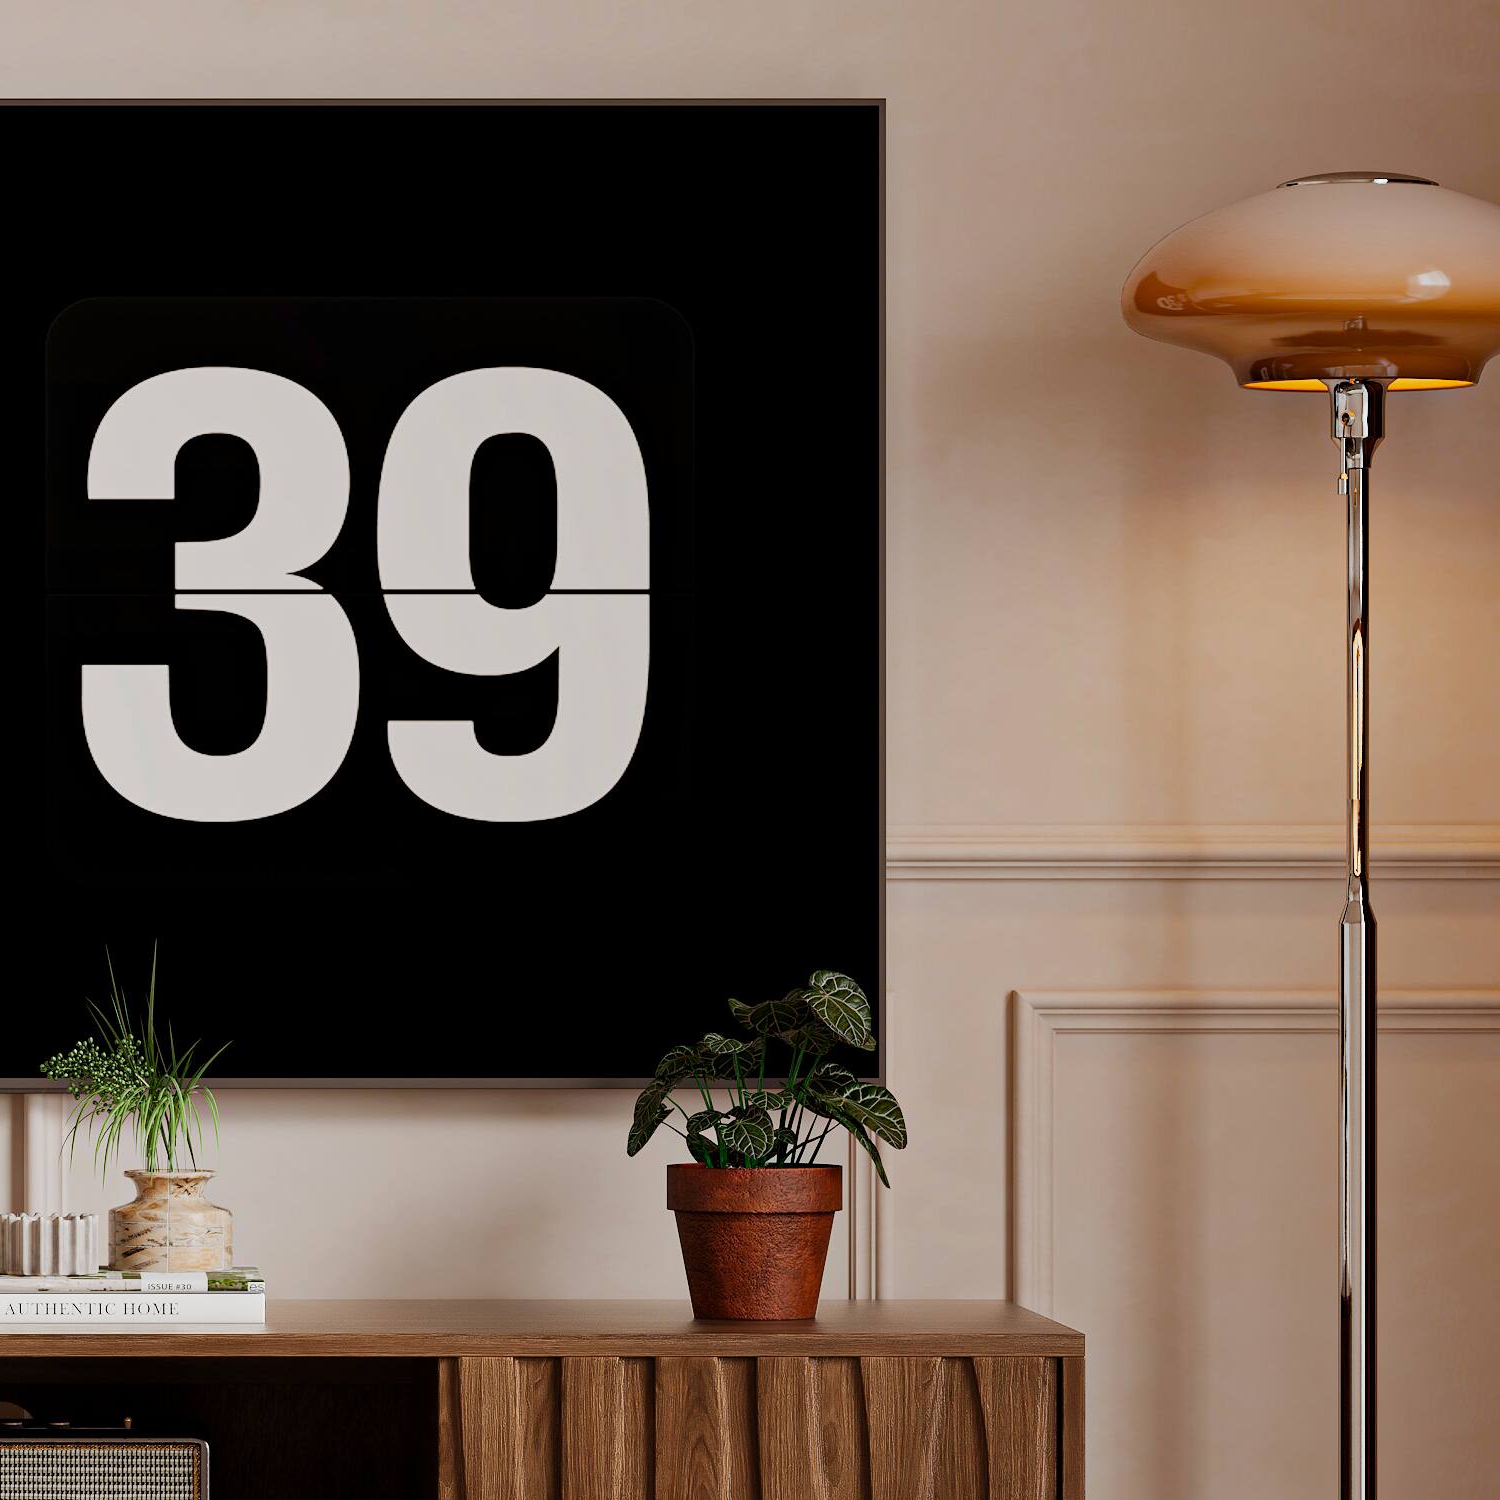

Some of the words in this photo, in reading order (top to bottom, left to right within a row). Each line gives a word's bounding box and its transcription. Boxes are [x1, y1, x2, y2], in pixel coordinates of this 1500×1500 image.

[81, 366, 651, 823] 39
[147, 1283, 174, 1291] ISSUE
[176, 1283, 193, 1291] #30
[4, 1301, 117, 1316] AUTHENTIC
[123, 1301, 180, 1316] HOME
